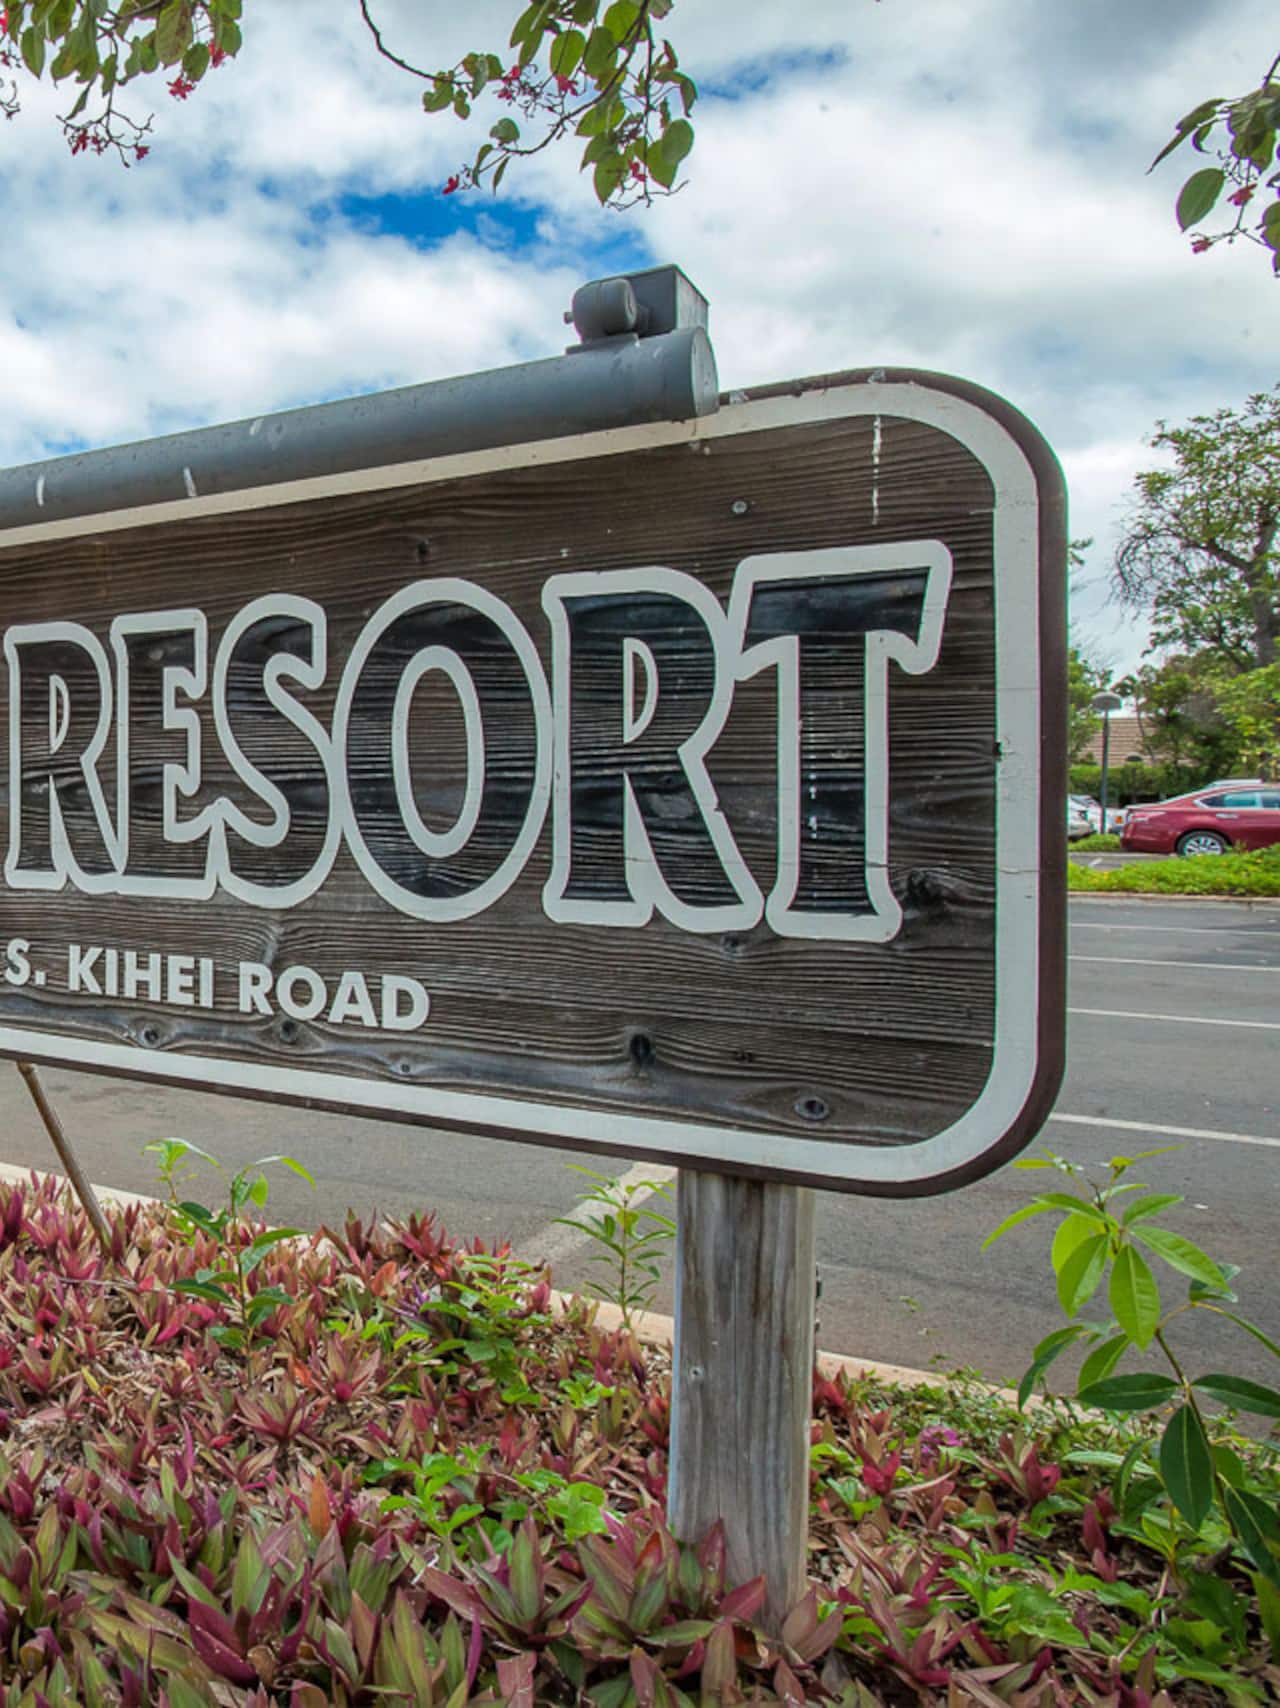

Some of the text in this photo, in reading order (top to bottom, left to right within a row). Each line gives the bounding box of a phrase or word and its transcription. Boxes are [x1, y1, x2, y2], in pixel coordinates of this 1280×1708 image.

[4, 540, 954, 944] RESORT
[3, 938, 46, 987] S.
[68, 944, 214, 1009] KIHEI
[239, 961, 430, 1032] ROAD
